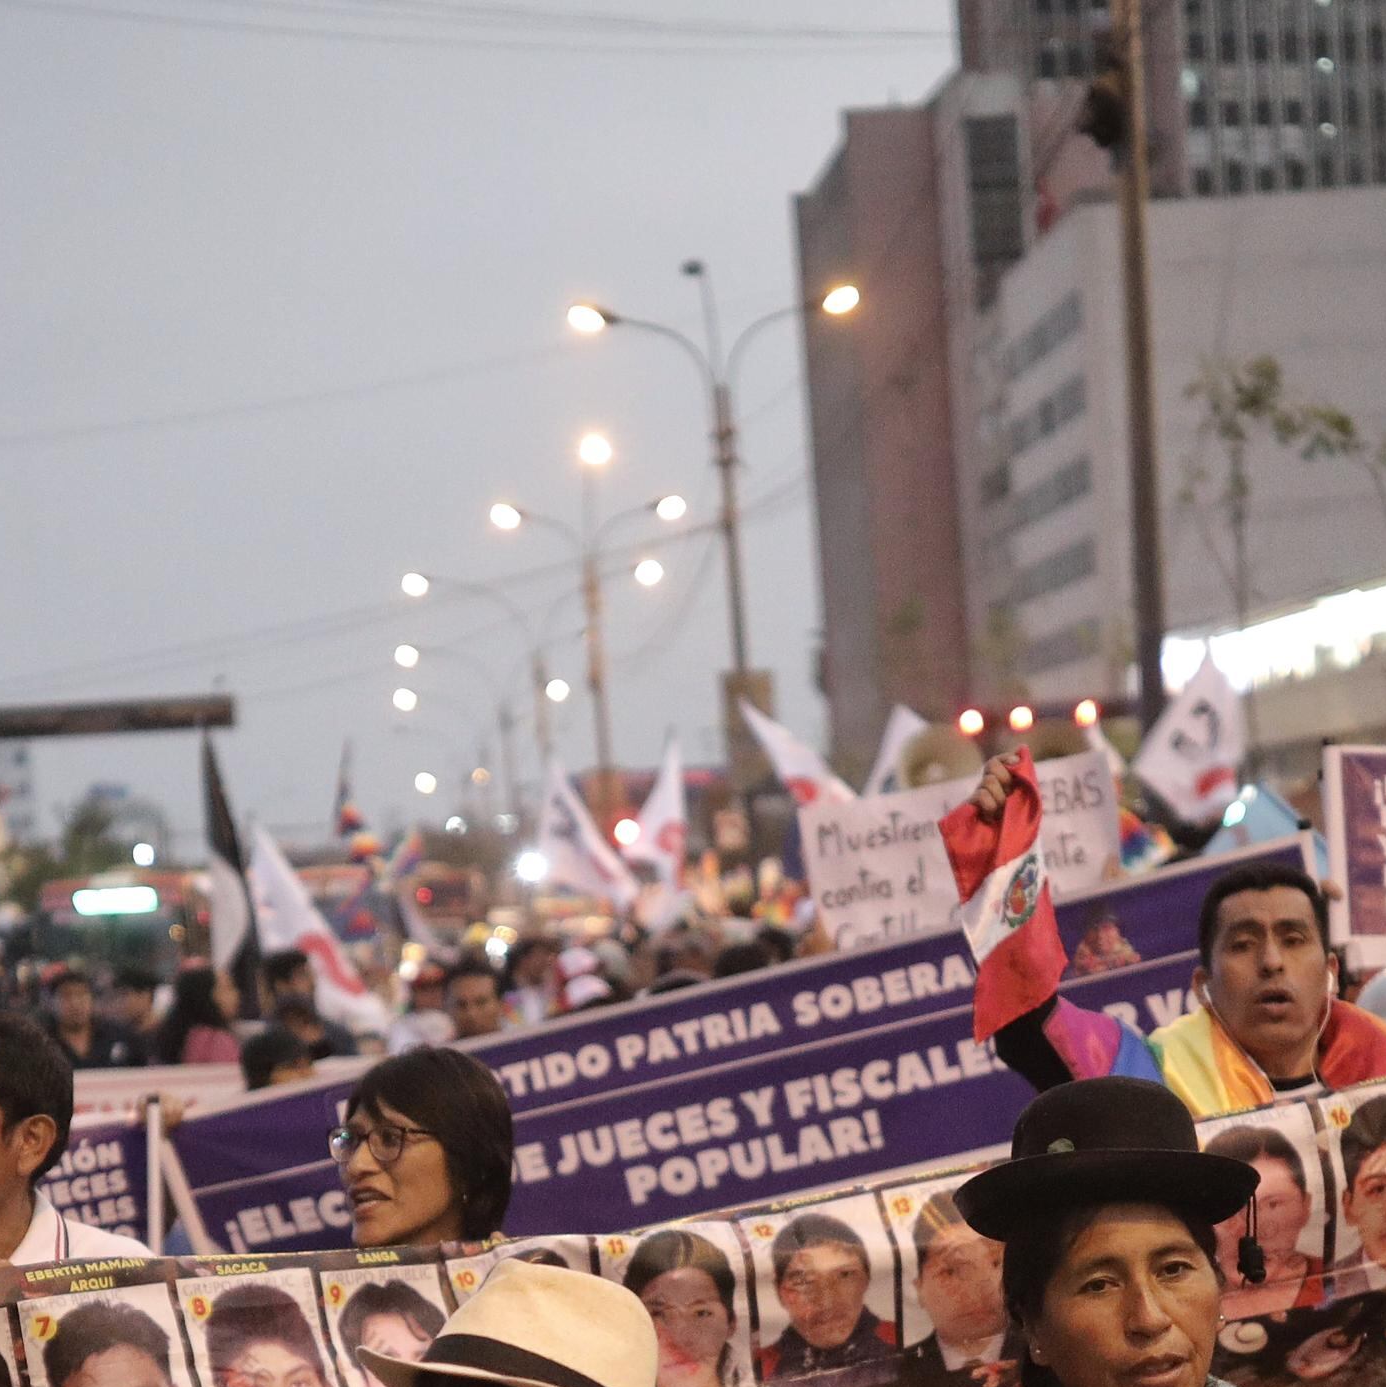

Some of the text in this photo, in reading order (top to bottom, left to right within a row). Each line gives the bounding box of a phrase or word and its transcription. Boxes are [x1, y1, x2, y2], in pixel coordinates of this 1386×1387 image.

[615, 1001, 782, 1072] PATRIA
[792, 953, 978, 1028] SOBERA
[1330, 1106, 1349, 1126] 16
[623, 1108, 886, 1207] POPULAR!
[223, 1189, 353, 1254] ¡ELEC
[557, 1096, 741, 1177] JUECES
[739, 1086, 776, 1130] Y
[892, 1197, 911, 1215] 13
[356, 1251, 400, 1264] SANGA
[25, 1257, 145, 1282] EBERTH MAMANI
[215, 1262, 268, 1276] SACACA
[69, 1276, 114, 1293] ARQUI
[455, 1270, 475, 1288] 10
[329, 1285, 341, 1304] 9
[193, 1297, 207, 1316] 8
[34, 1316, 52, 1337] 7
